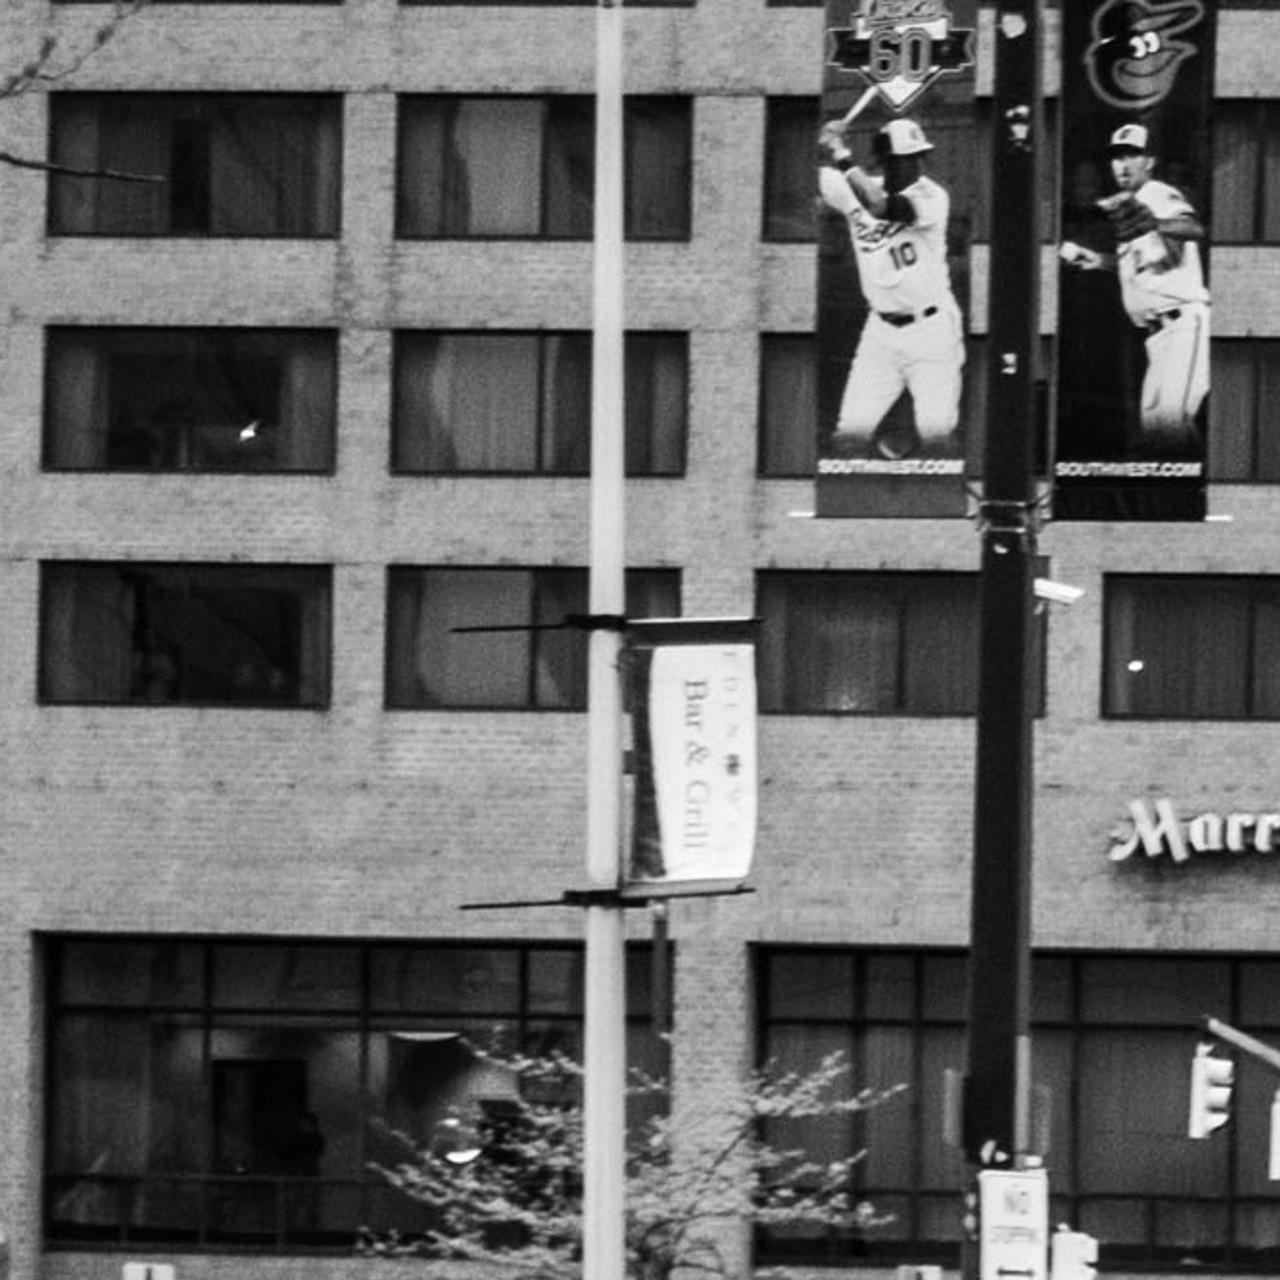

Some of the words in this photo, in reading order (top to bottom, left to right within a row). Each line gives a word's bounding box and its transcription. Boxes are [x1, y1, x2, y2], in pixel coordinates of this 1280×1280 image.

[870, 27, 932, 82] 60
[889, 241, 917, 271] 10
[818, 458, 965, 475] SOUTHWEST.COM
[1055, 462, 1201, 477] SOUTHWEST.COM
